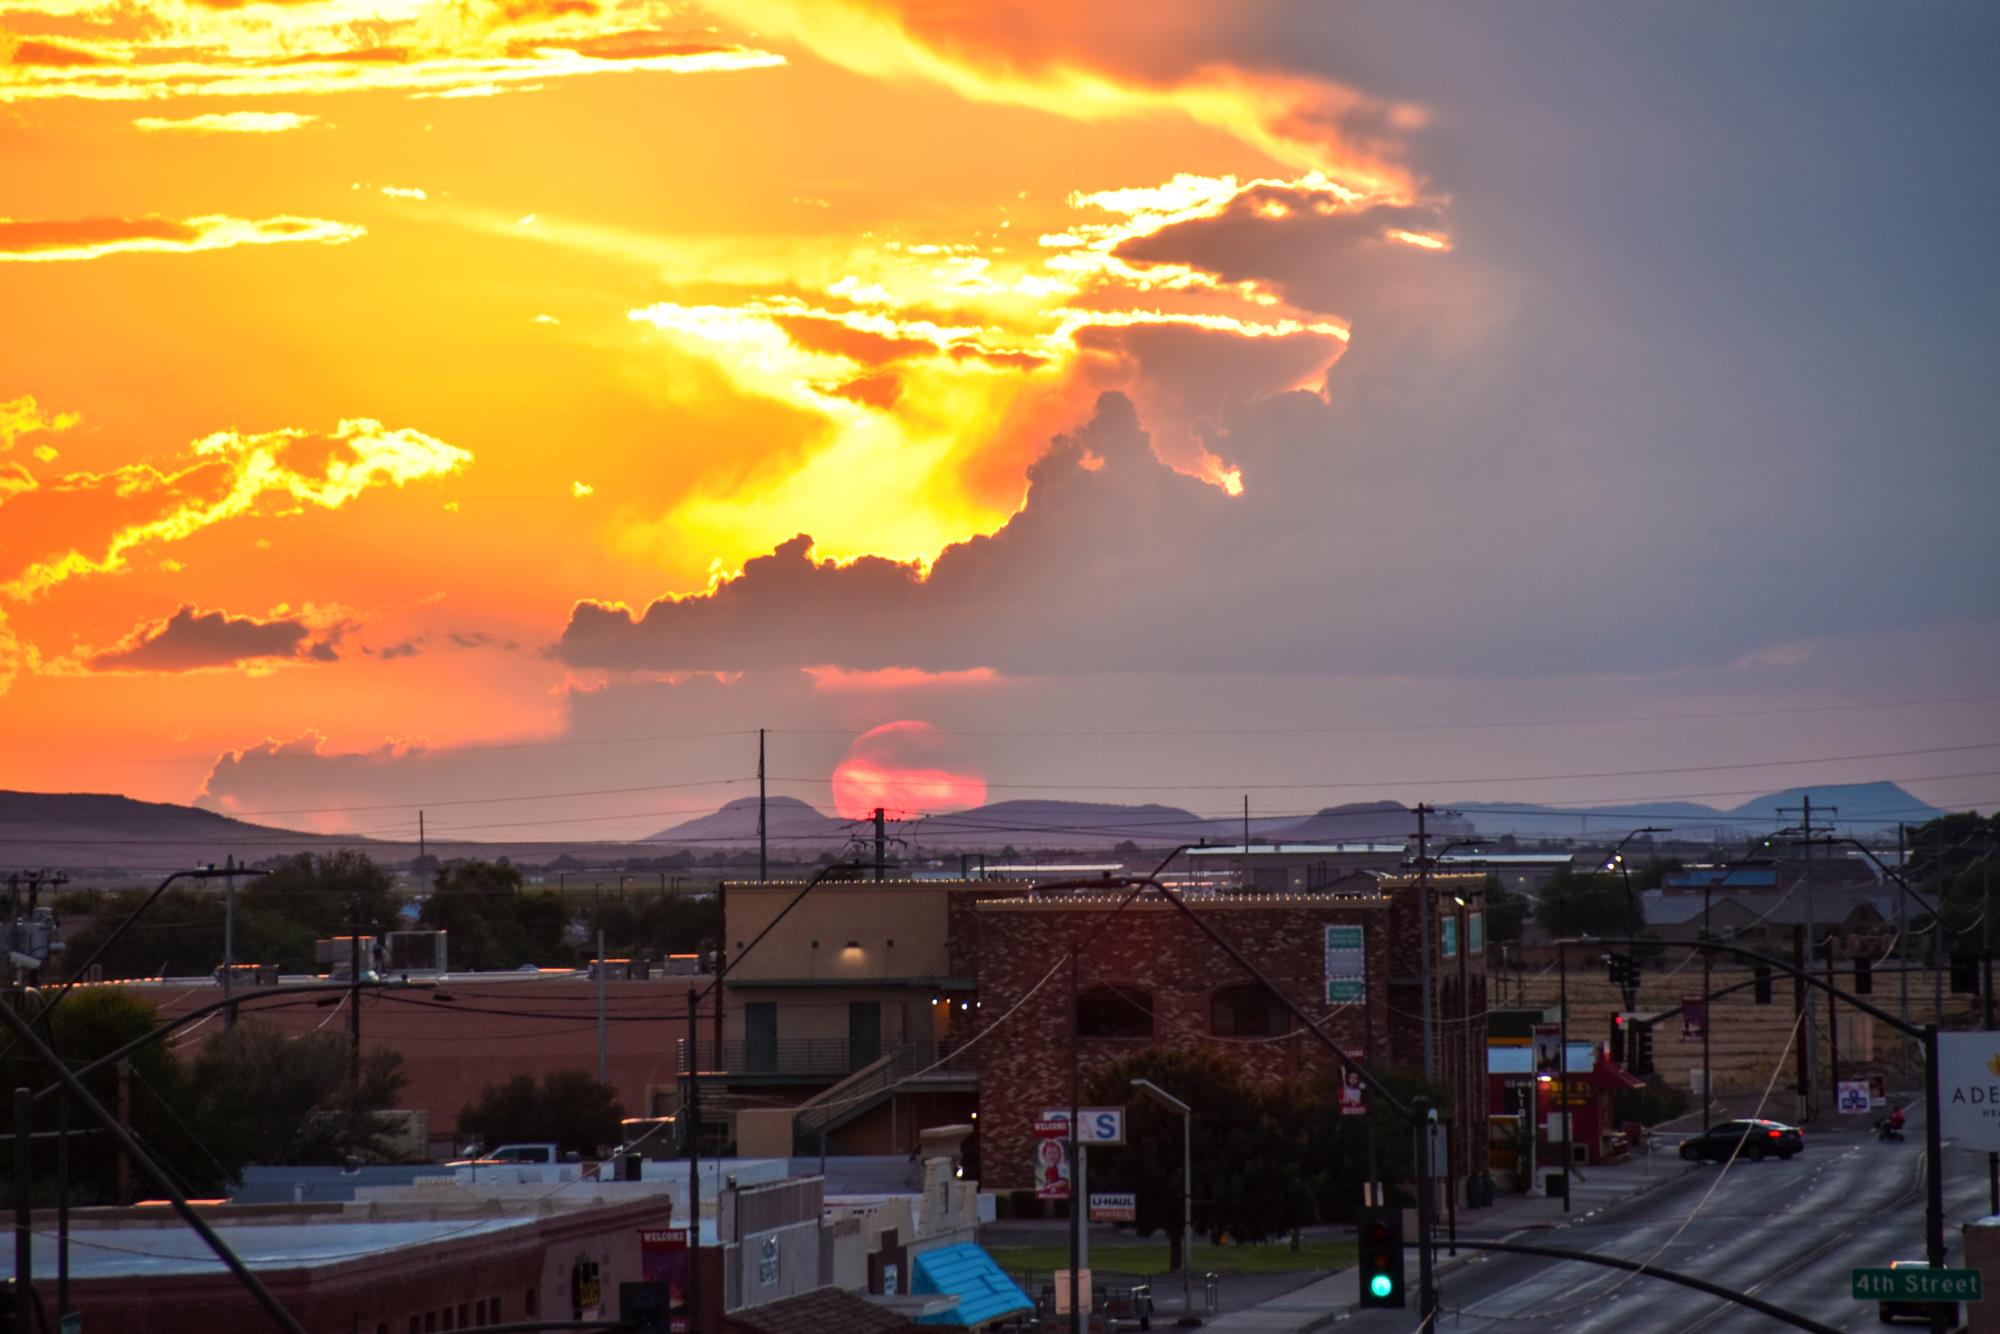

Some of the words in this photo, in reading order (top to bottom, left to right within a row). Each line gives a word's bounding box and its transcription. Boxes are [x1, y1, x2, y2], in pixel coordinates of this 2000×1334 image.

[1982, 1108, 2000, 1118] HE
[1034, 1121, 1067, 1131] WELCOME
[1092, 1196, 1133, 1206] U-HAUL
[643, 1231, 685, 1243] WELCOME
[1856, 1274, 1895, 1293] 4th
[1905, 1274, 1979, 1293] Street
